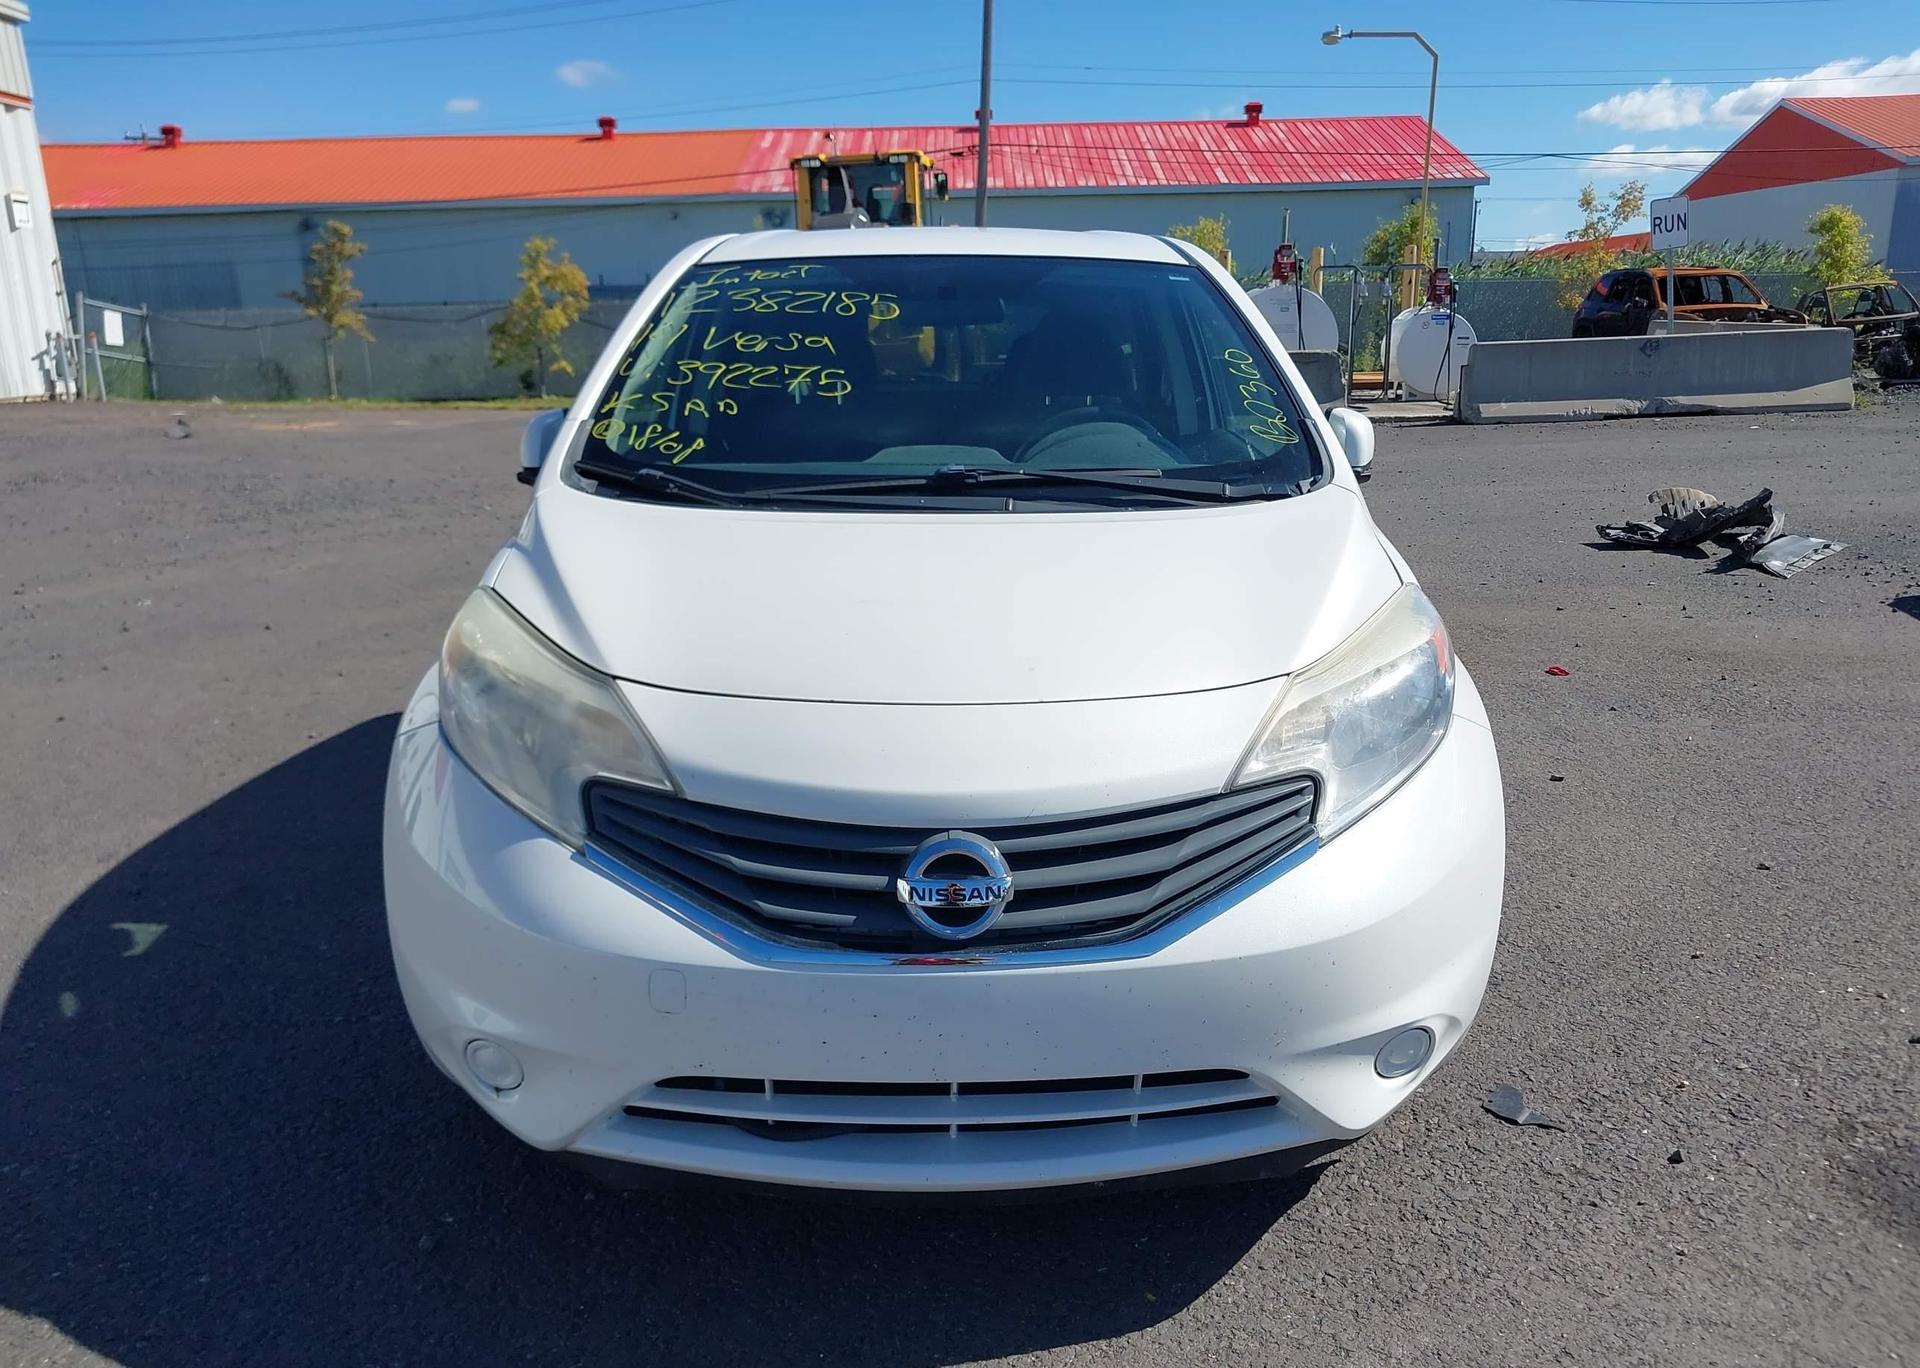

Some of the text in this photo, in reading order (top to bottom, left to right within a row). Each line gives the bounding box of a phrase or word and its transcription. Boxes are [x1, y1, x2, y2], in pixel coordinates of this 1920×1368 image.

[1653, 212, 1687, 235] RUN
[703, 326, 837, 355] Versa
[909, 885, 1003, 902] NISSAN
